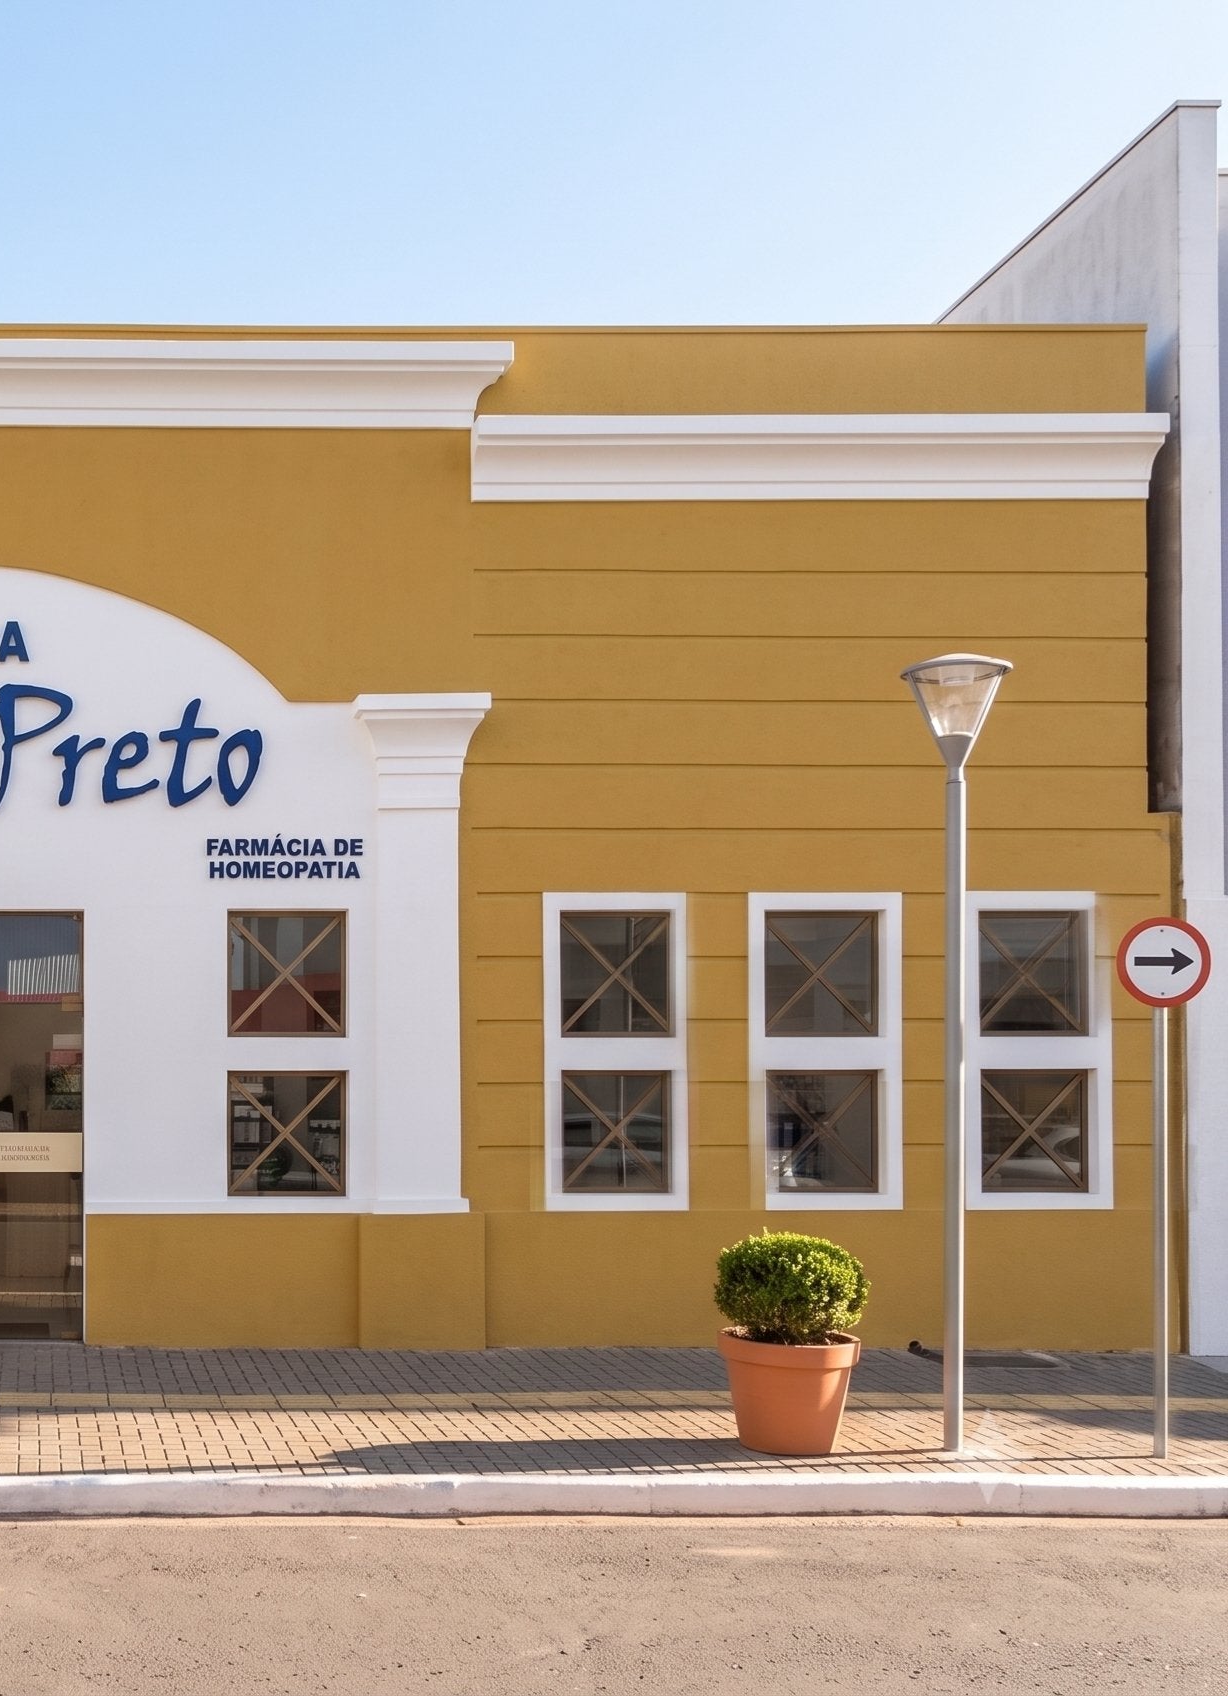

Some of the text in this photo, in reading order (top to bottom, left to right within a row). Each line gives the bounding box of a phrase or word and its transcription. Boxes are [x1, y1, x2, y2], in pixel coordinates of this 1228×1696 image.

[206, 834, 364, 857] FARMÁCIA DE
[209, 860, 361, 880] HOMEOPATIA
